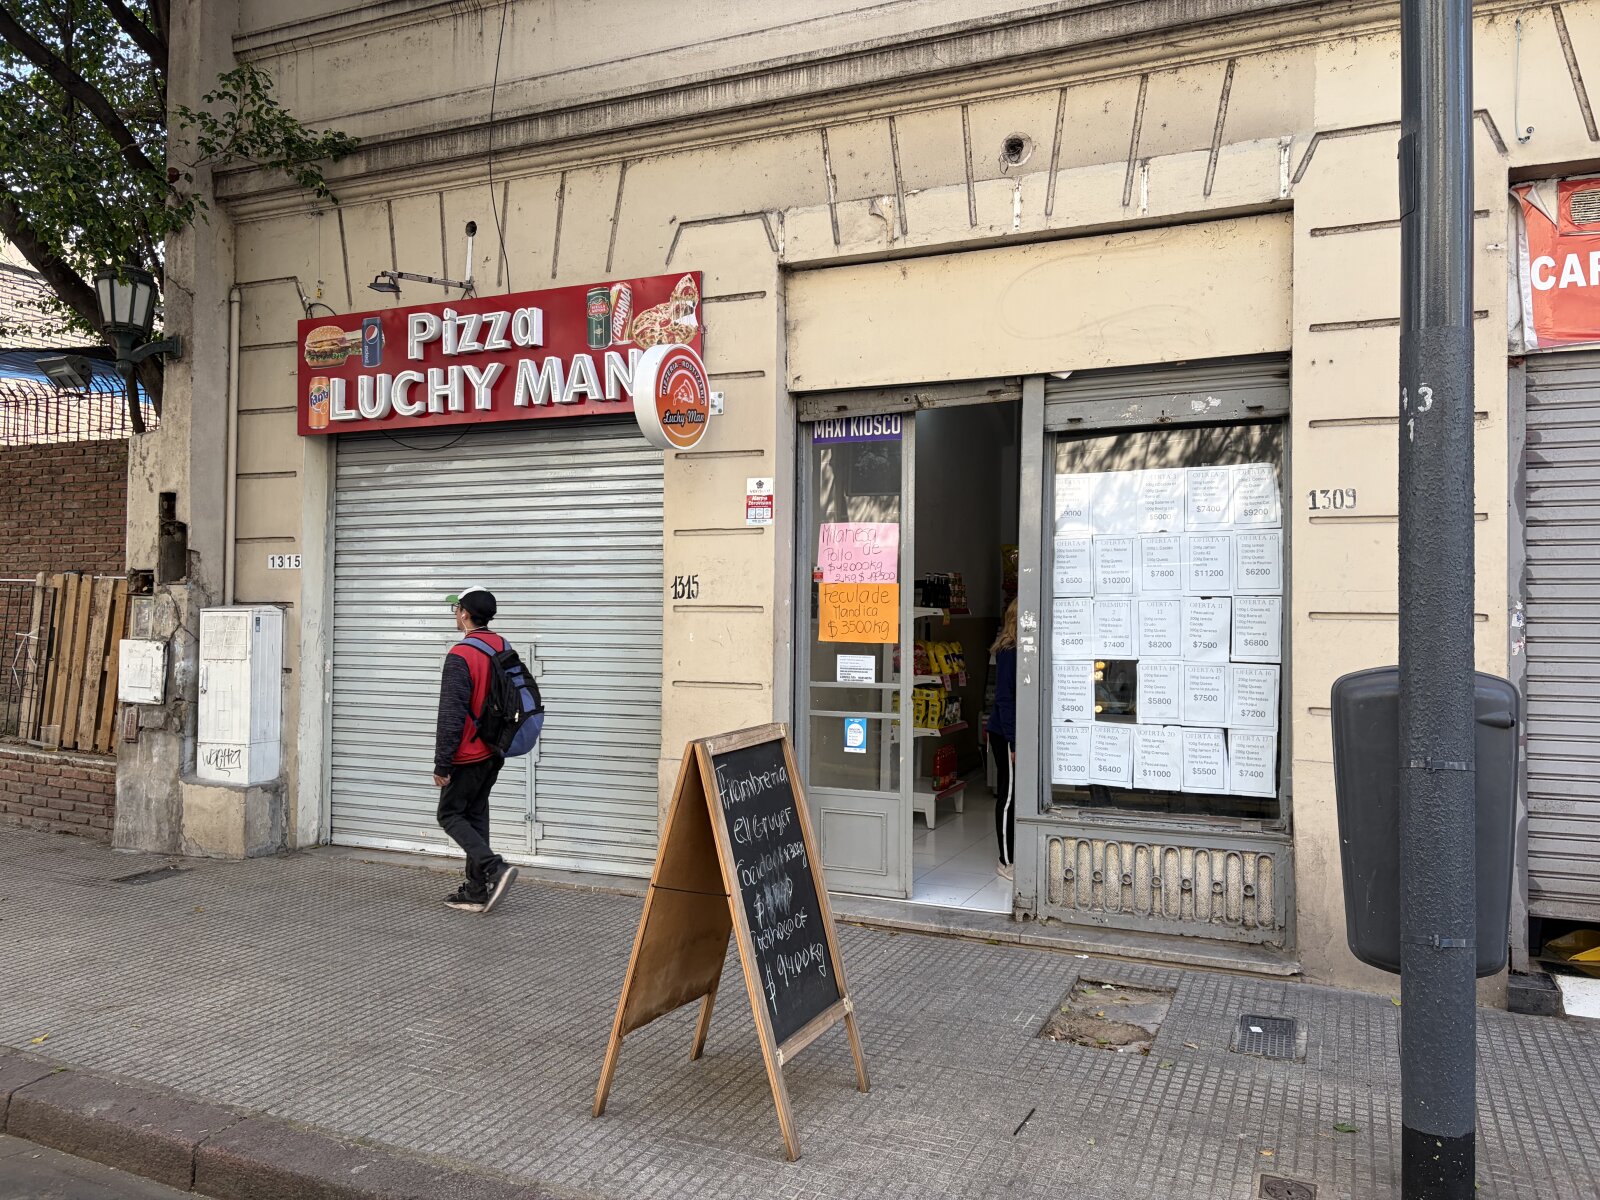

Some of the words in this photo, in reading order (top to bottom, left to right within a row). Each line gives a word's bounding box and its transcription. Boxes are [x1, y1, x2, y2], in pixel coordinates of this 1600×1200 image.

[612, 287, 632, 338] BRAHMA
[408, 308, 543, 361] Pizza
[662, 362, 679, 396] PIZZERIA
[329, 362, 505, 421] LUCHY
[513, 348, 643, 407] MAN
[687, 409, 706, 424] Man
[814, 418, 846, 439] MAXI
[850, 414, 901, 437] KIOSCO
[1308, 488, 1357, 510] 1309
[1196, 505, 1221, 513] $7400
[1243, 508, 1269, 517] $9200
[822, 524, 878, 546] Milanesa
[862, 542, 882, 556] de
[823, 547, 853, 562] Pollo
[270, 555, 301, 568] 1315
[1150, 570, 1174, 578] $7800
[1245, 568, 1271, 576] $6200
[670, 574, 699, 600] 1315
[1060, 638, 1084, 646] $6400
[1148, 640, 1172, 648] $8200
[1192, 640, 1218, 649] $7500
[1244, 638, 1269, 647] $6800
[1148, 697, 1172, 705] $5800
[1193, 694, 1218, 702] $7500
[1061, 704, 1084, 712] $4900
[1240, 709, 1266, 718] $7200
[1058, 764, 1086, 772] $10300
[1098, 764, 1122, 774] $6400
[1192, 768, 1217, 776] $5500
[1142, 769, 1172, 778] $11000
[1238, 770, 1264, 778] $7400
